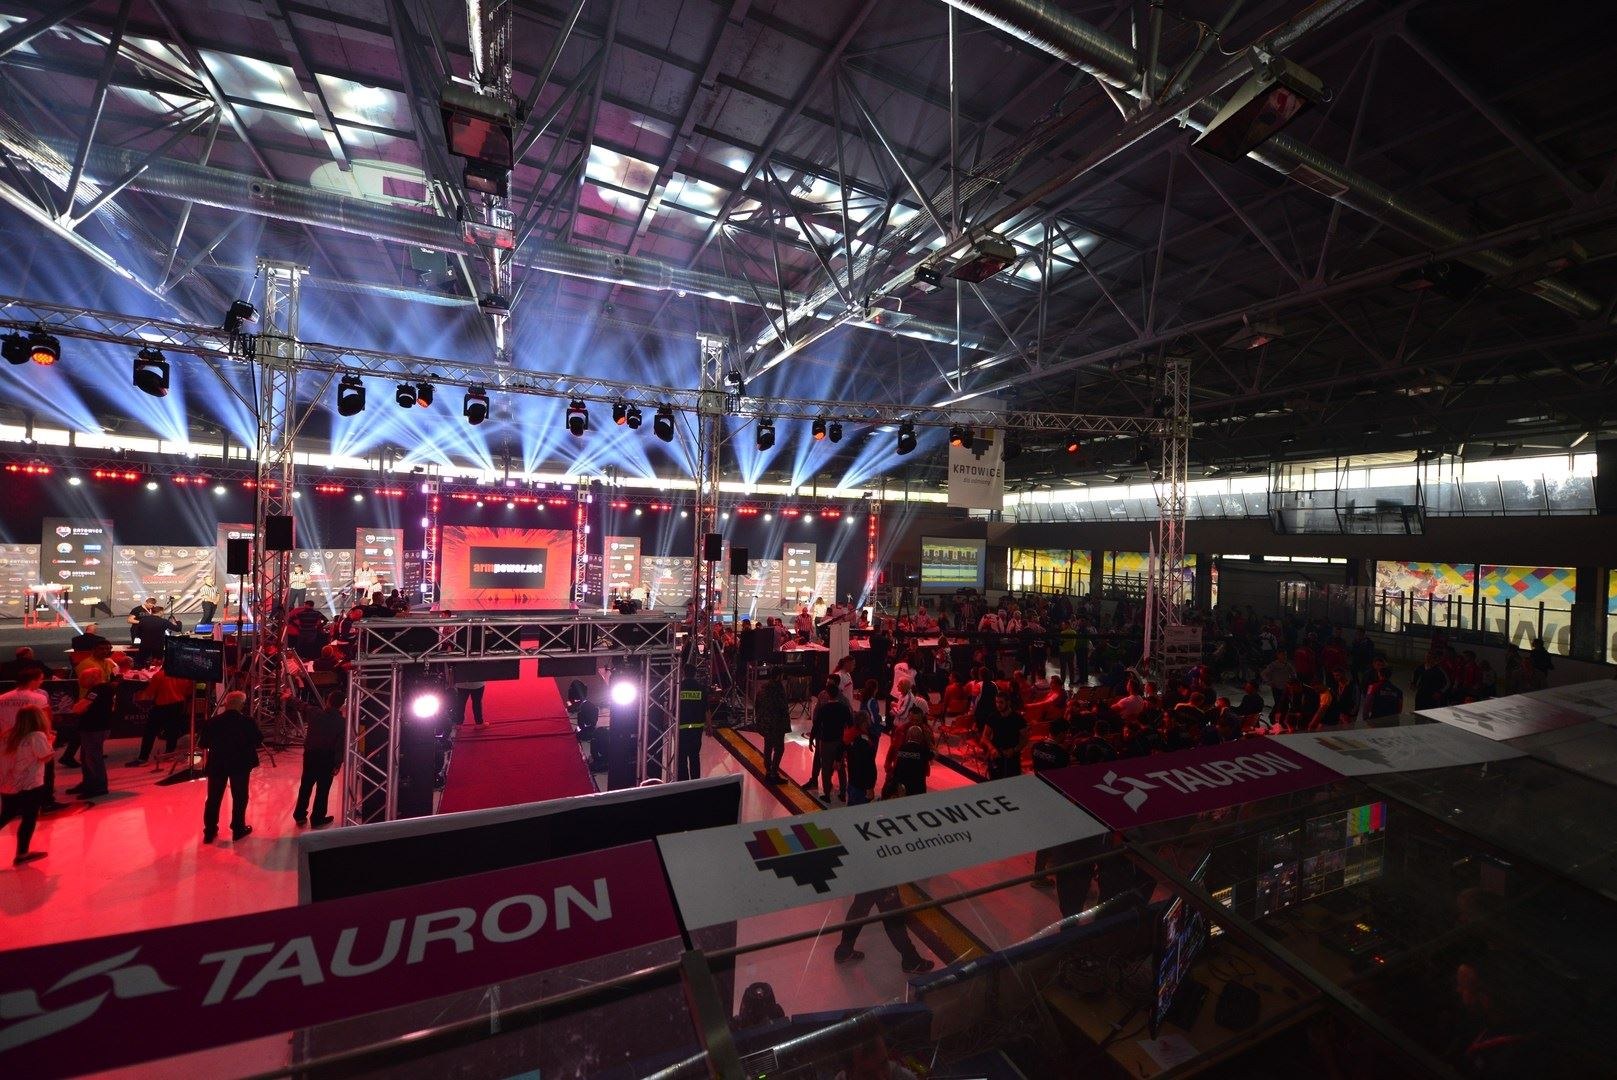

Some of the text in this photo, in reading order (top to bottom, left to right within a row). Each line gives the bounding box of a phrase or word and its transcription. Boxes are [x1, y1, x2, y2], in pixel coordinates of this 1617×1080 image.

[953, 464, 1001, 478] KATOWICE
[473, 563, 543, 574] armpower.net
[1145, 752, 1302, 793] TAURON
[854, 796, 1019, 841] KATOWICE
[876, 829, 973, 859] dla odmiany
[200, 877, 613, 1007] TAURON
